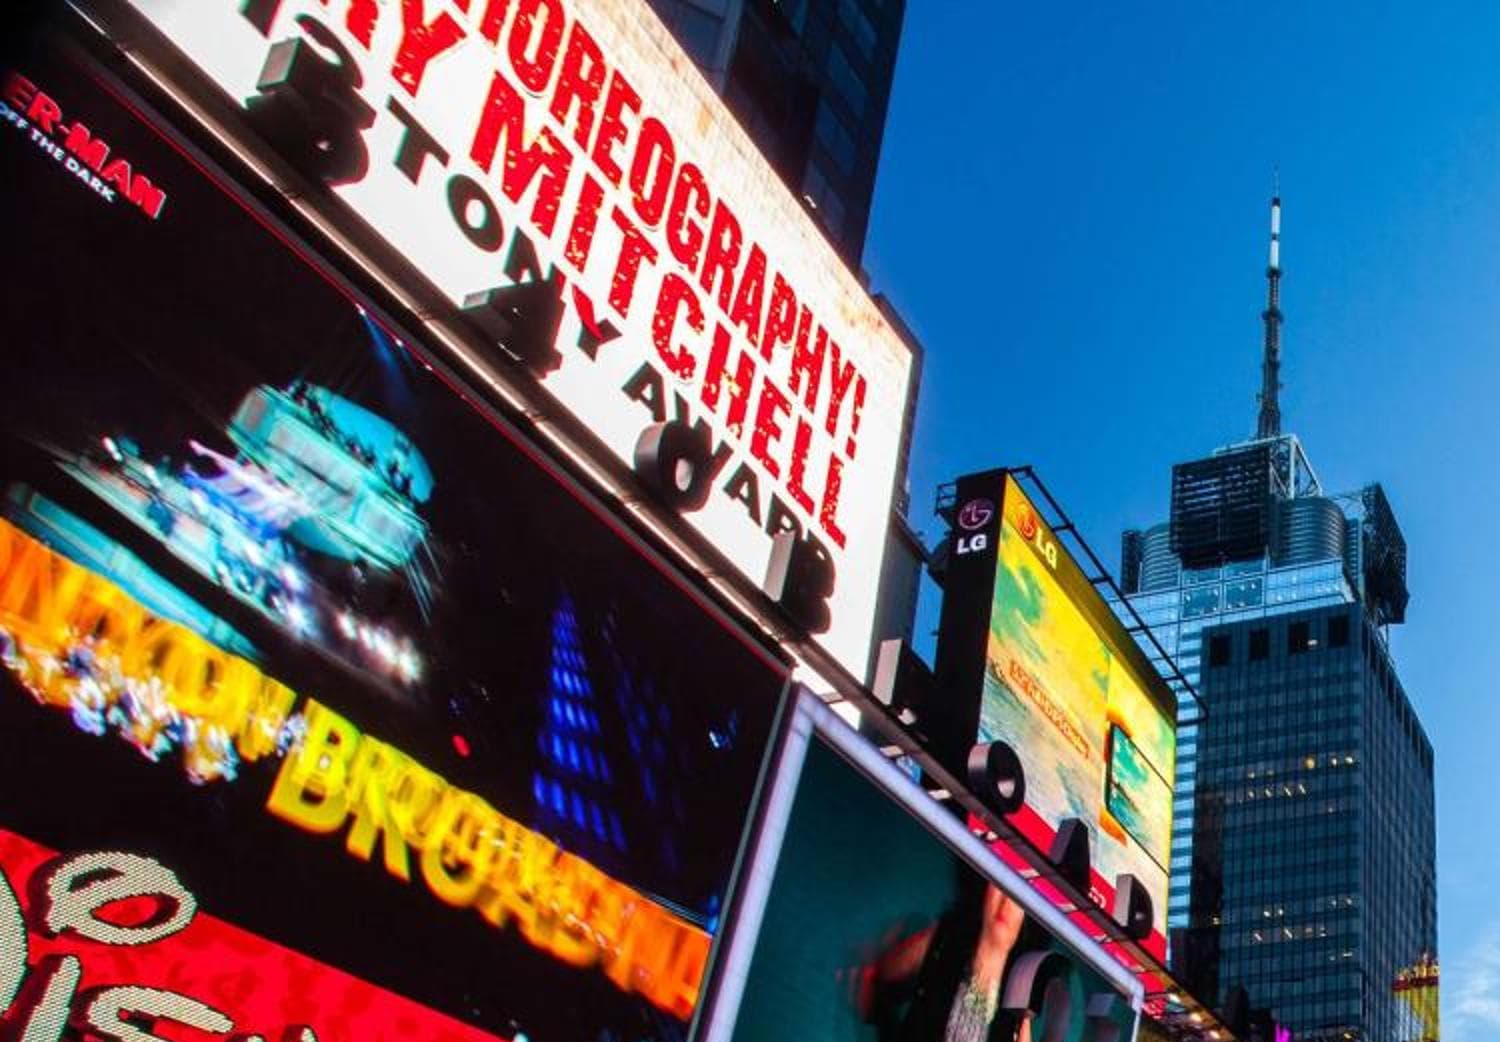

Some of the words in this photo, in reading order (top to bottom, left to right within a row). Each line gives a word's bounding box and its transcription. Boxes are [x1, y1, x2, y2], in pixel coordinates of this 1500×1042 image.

[31, 127, 65, 161] THE
[65, 156, 119, 204] DARK
[387, 96, 623, 361] TONY
[453, 0, 867, 460] OREOGRAPHY!
[470, 72, 847, 550] MITCHELL
[957, 532, 987, 554] LG
[1035, 526, 1058, 570] LG
